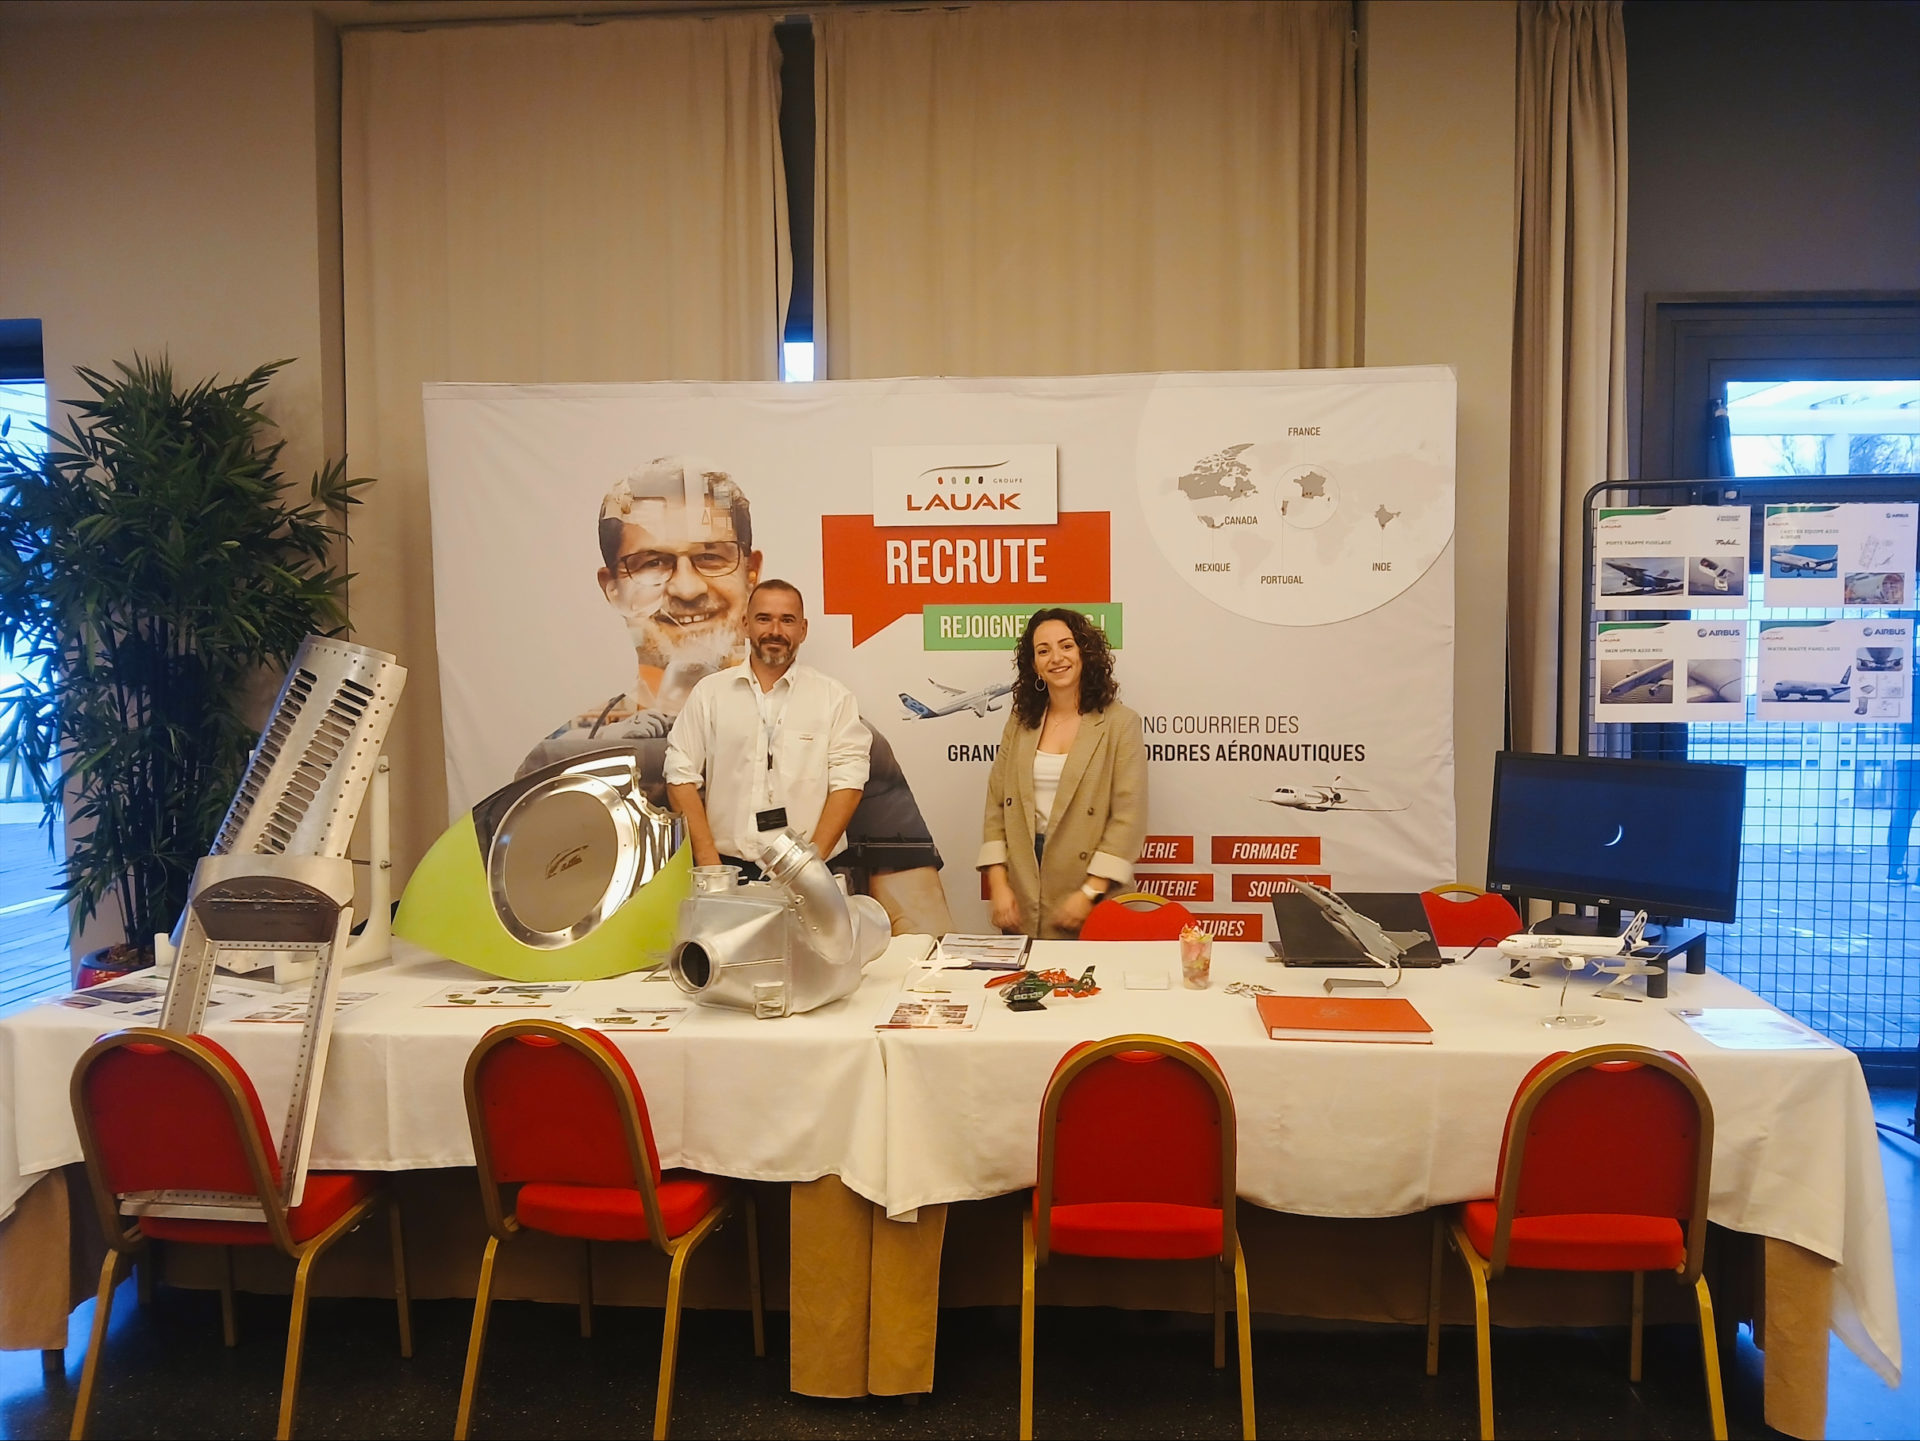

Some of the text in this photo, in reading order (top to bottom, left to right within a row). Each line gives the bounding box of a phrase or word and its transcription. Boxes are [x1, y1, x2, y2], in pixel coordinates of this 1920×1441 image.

[1288, 427, 1321, 436] FRANCE
[906, 493, 1021, 511] LAUAK
[1224, 516, 1258, 525] CANADA
[886, 538, 1047, 584] RECRUTE
[1195, 563, 1231, 572] MEXIQUE
[1372, 562, 1392, 572] INDE
[1260, 576, 1304, 585] PORTUGAL
[940, 614, 1033, 638] REJOIGNE
[1144, 715, 1299, 734] NG COURRIER DES
[947, 744, 1000, 762] GRAN
[1215, 739, 1365, 763] AÉRONAUTIQUES
[1231, 842, 1300, 860] FORMAGE
[1134, 880, 1199, 897] YAUTERIE
